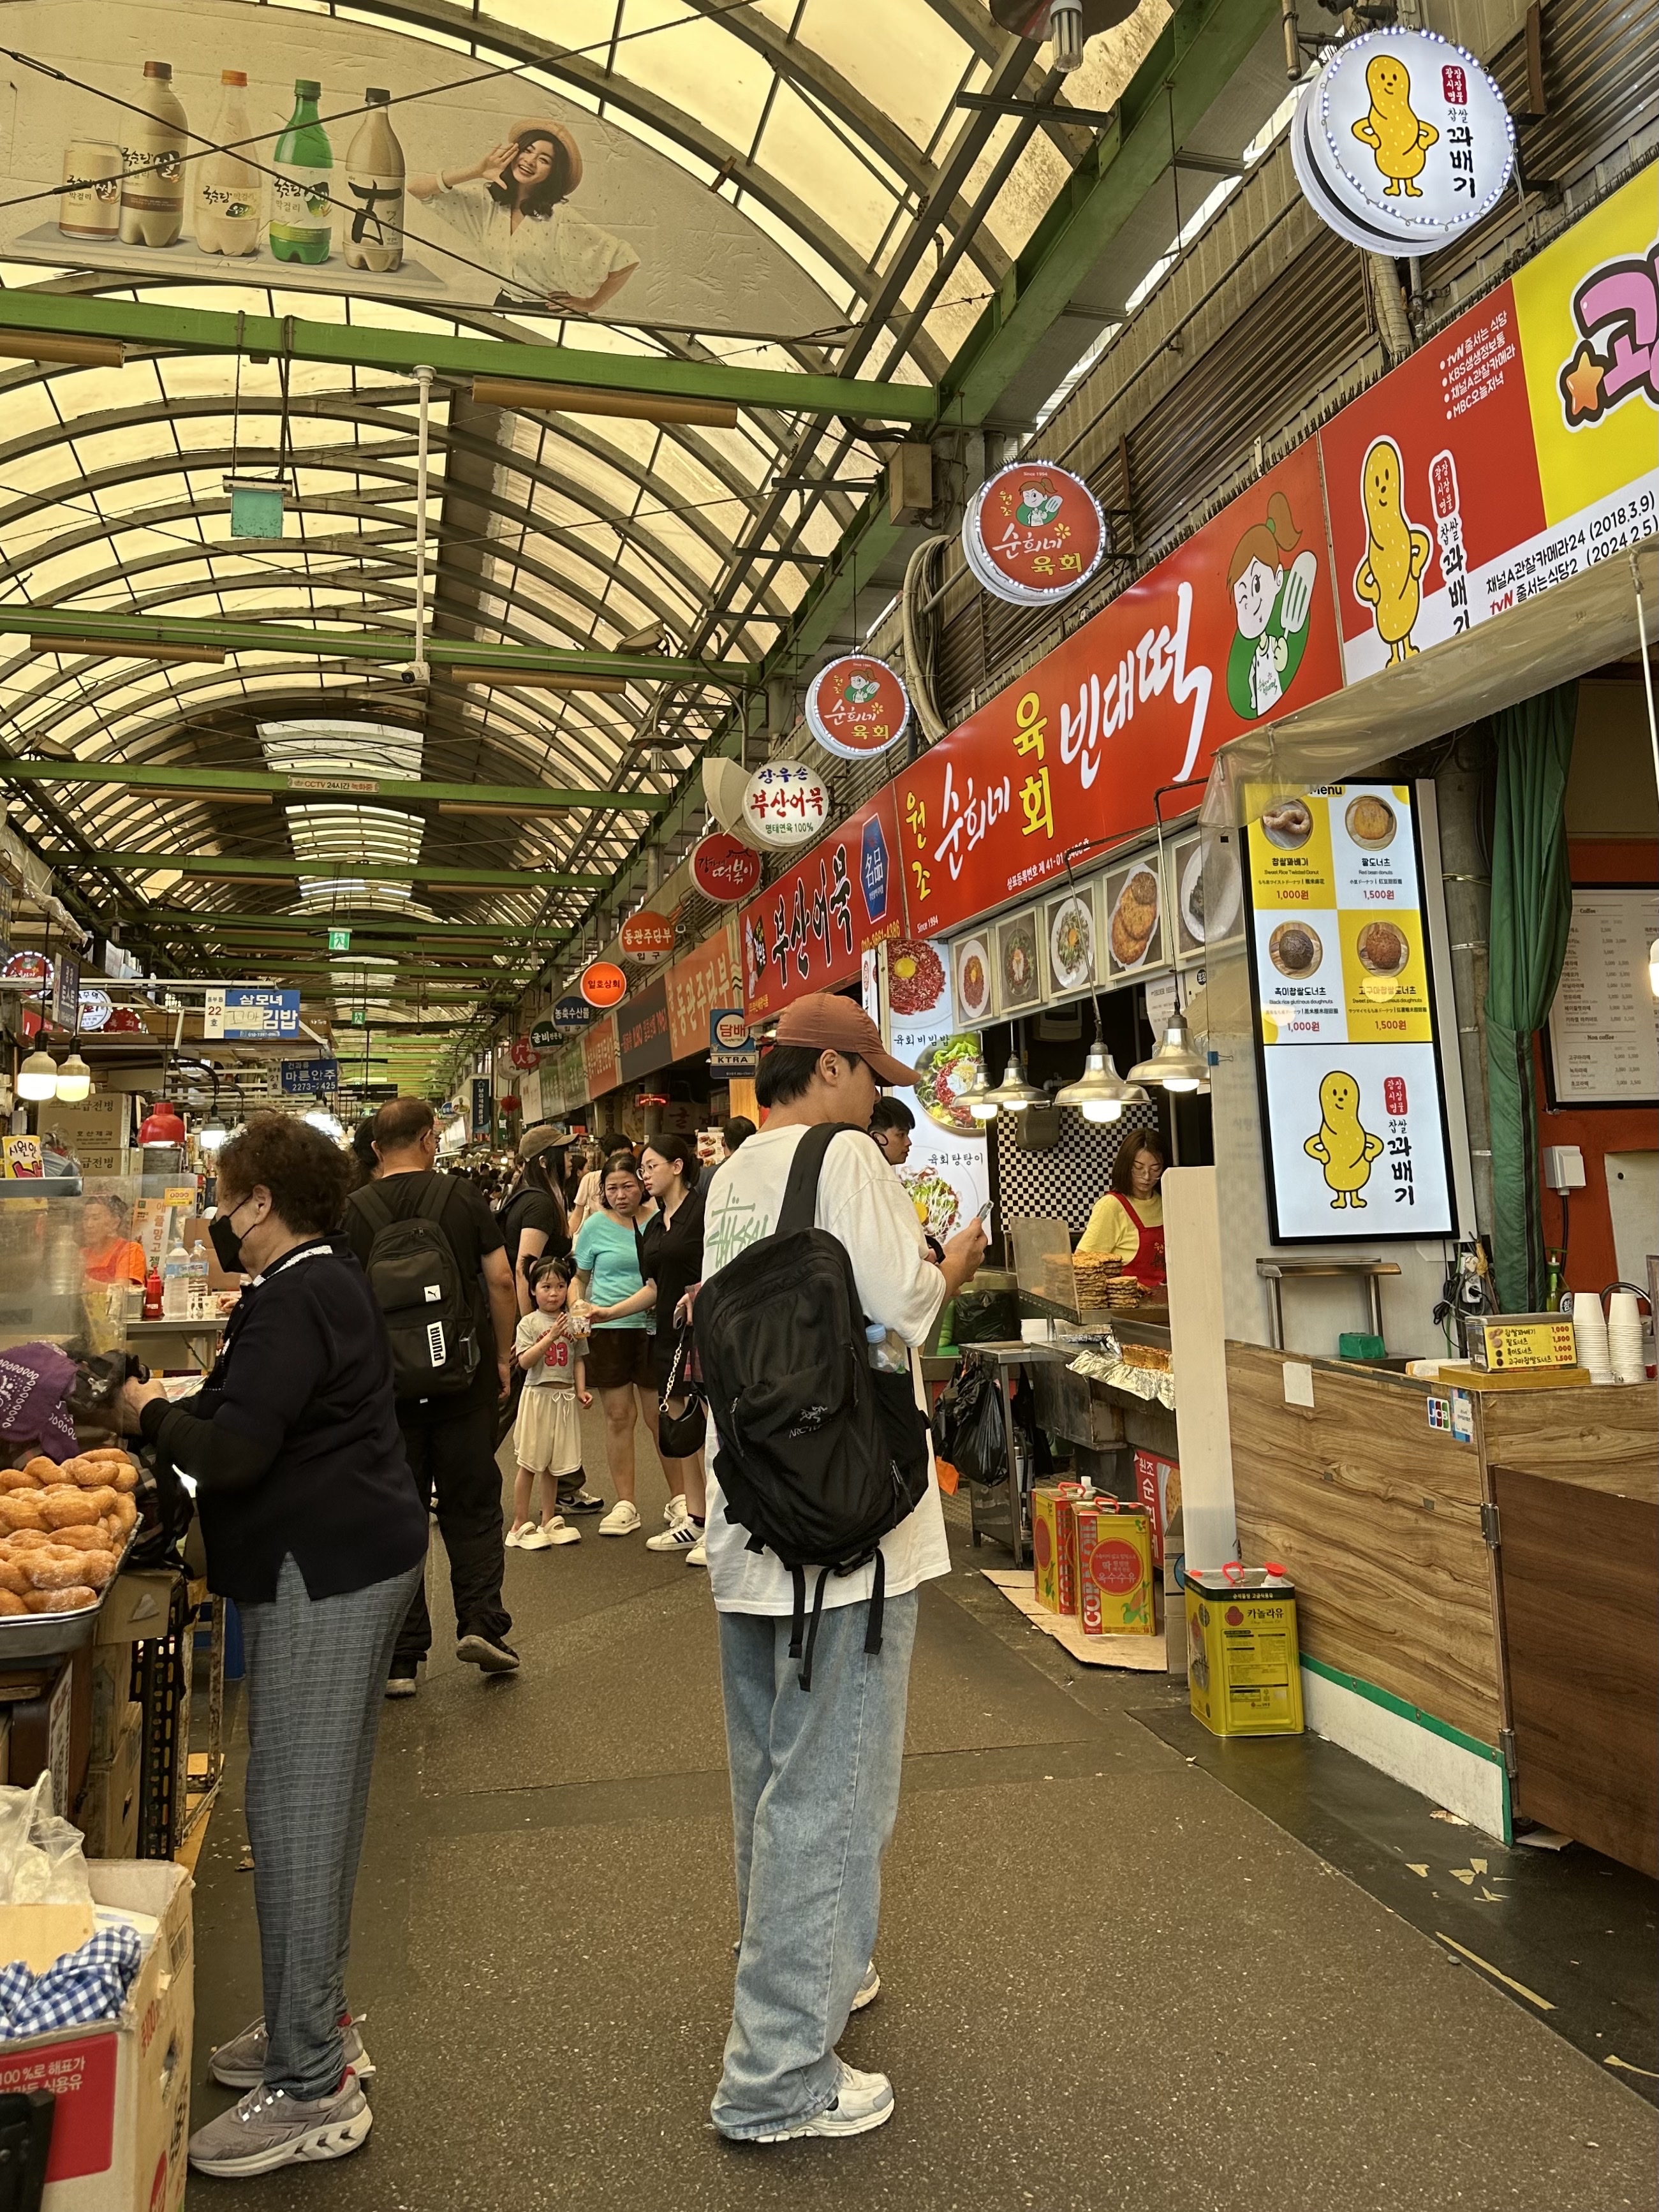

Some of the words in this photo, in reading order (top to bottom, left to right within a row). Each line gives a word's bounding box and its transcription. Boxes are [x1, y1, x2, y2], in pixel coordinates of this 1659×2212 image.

[1445, 68, 1462, 79] 광장
[1446, 80, 1462, 91] 시장
[1447, 91, 1463, 103] 명물
[1447, 108, 1468, 123] 찹쌀
[1447, 126, 1475, 198] 꽈배기
[69, 192, 92, 201] 막걸리
[203, 186, 232, 204] 국순당
[276, 200, 300, 213] 막걸리
[1447, 343, 1464, 367] tvN
[1464, 328, 1489, 354] 줄서는
[1490, 310, 1507, 332] 식당
[1450, 343, 1516, 400] 채널A관찰카메라
[1452, 371, 1504, 418] MBC오늘저녁
[1434, 461, 1449, 480] 광장
[1437, 478, 1450, 496] 시장
[998, 490, 1013, 517] 원조
[1440, 495, 1453, 513] 명물
[1440, 518, 1458, 545] 찹쌀
[992, 522, 1062, 559] 순희네
[1486, 529, 1586, 594] 채널A관찰카메라24
[1589, 490, 1655, 541] (2018.3.9)
[1031, 552, 1083, 576] 육회
[1490, 589, 1513, 615] tvN
[824, 698, 877, 725] 순희네
[851, 725, 889, 740] 육회
[906, 790, 931, 901] 원조
[934, 763, 1012, 881] 순희네
[1012, 691, 1056, 839] 육회
[1059, 581, 1213, 790] 빈대떡
[758, 767, 809, 784] 장우손
[327, 781, 350, 790] 24시간
[351, 783, 372, 791] 녹화중
[750, 786, 824, 819] 부산어묵
[765, 823, 793, 834] 명태연육
[794, 822, 814, 833] 100%
[1272, 857, 1308, 866] 찹쌀꽈배기
[712, 859, 753, 885] 떡볶이
[1006, 866, 1038, 891] 상표등록번호
[1038, 864, 1045, 874] 제
[1276, 890, 1309, 900] 1,000원
[1363, 890, 1394, 900] 1,500원
[772, 843, 853, 989] 부산어묵
[917, 920, 927, 934] Since
[927, 915, 938, 930] 1994
[624, 927, 672, 945] 동관주단부
[637, 952, 660, 961] 입구
[587, 980, 621, 989] 일호상회
[240, 994, 283, 1006] 삼모녀
[208, 1006, 222, 1015] 22
[210, 1018, 218, 1027] 호
[263, 1009, 299, 1030] 김밥
[1375, 1020, 1406, 1031] 1,500원
[719, 1024, 746, 1038] 담배
[1287, 1022, 1320, 1032] 1,000원
[532, 1031, 550, 1044] 굴비
[288, 1061, 309, 1070] 건과류
[285, 1069, 336, 1082] 마른안주
[1389, 1091, 1403, 1102] 시장
[70, 1100, 114, 1112] 고급전병
[1389, 1119, 1407, 1133] 찹쌀
[81, 1156, 114, 1169] 급전병
[1387, 1137, 1414, 1206] 꽈배기
[1551, 1325, 1570, 1334] 1,000
[545, 1341, 568, 1366] 93
[1429, 1408, 1449, 1420] JCB
[1096, 1572, 1137, 1584] 옥수수유
[1247, 1608, 1285, 1619] 카놀라유
[48, 2055, 86, 2076] 해표가
